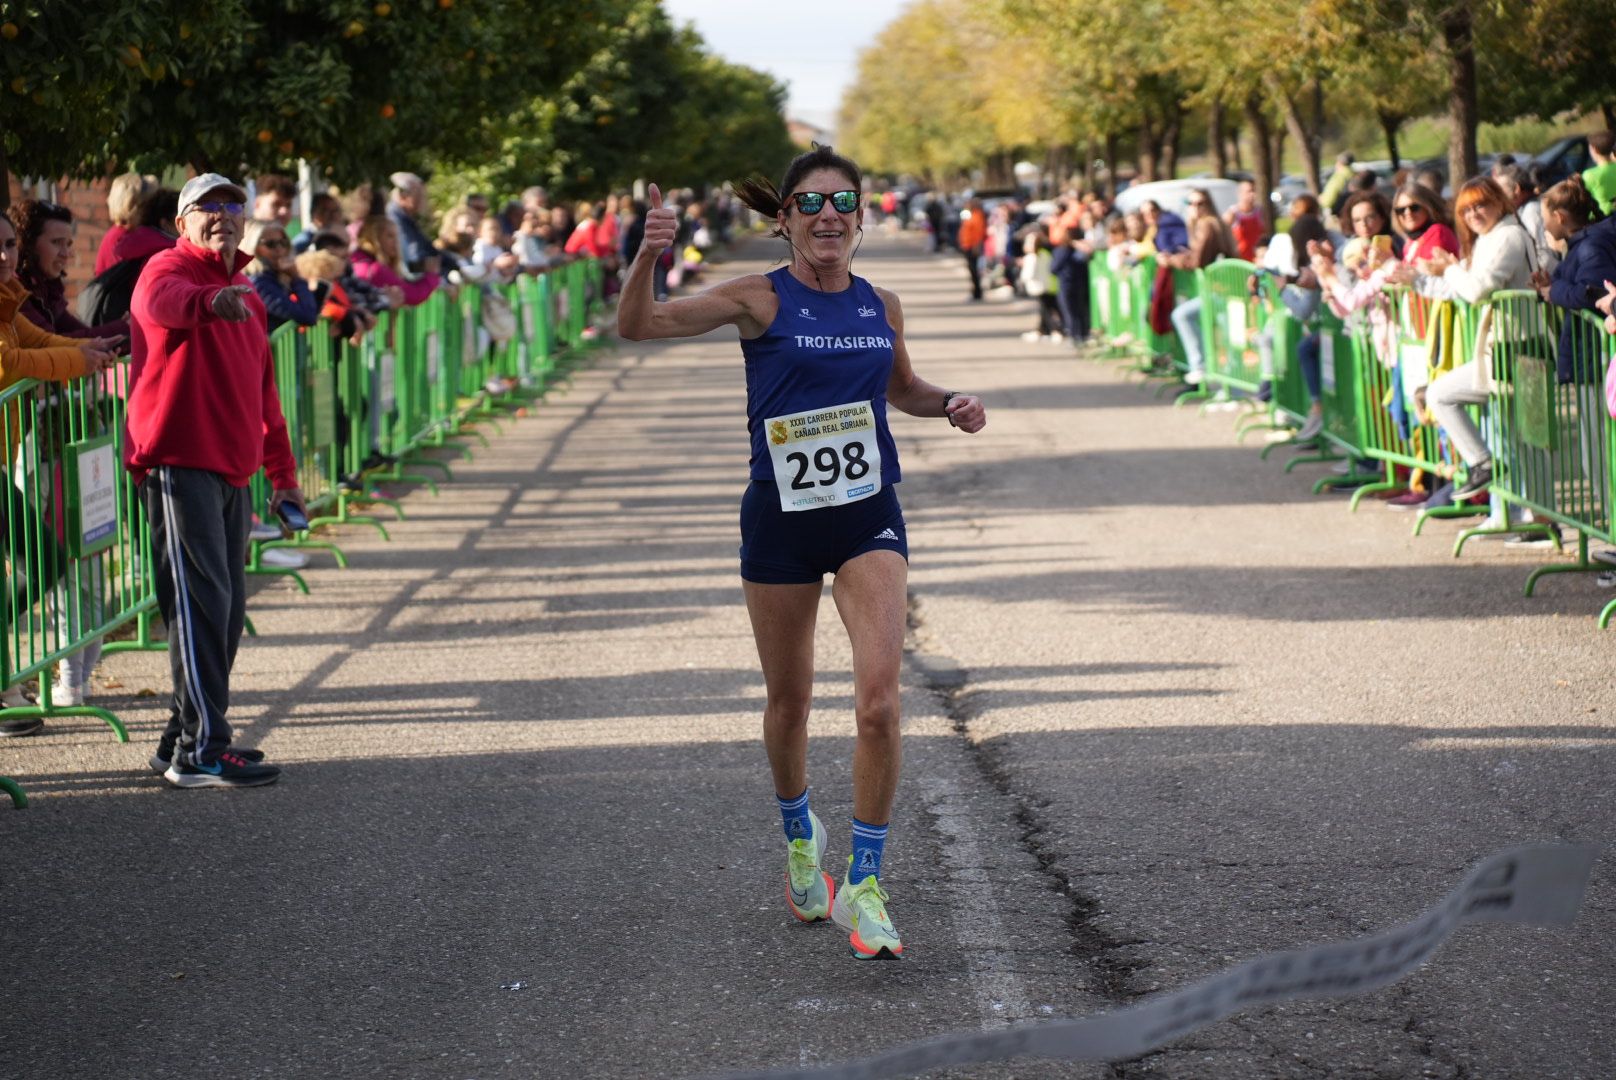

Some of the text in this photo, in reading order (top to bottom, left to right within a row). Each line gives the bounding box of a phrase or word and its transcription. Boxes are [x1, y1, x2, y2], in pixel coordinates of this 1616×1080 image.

[795, 335, 893, 350] TROTASIERRA
[807, 411, 838, 425] CARRERA
[839, 406, 868, 419] POPULAR
[794, 418, 868, 439] CAÑADA REAL SORIANA
[786, 441, 869, 490] 298
